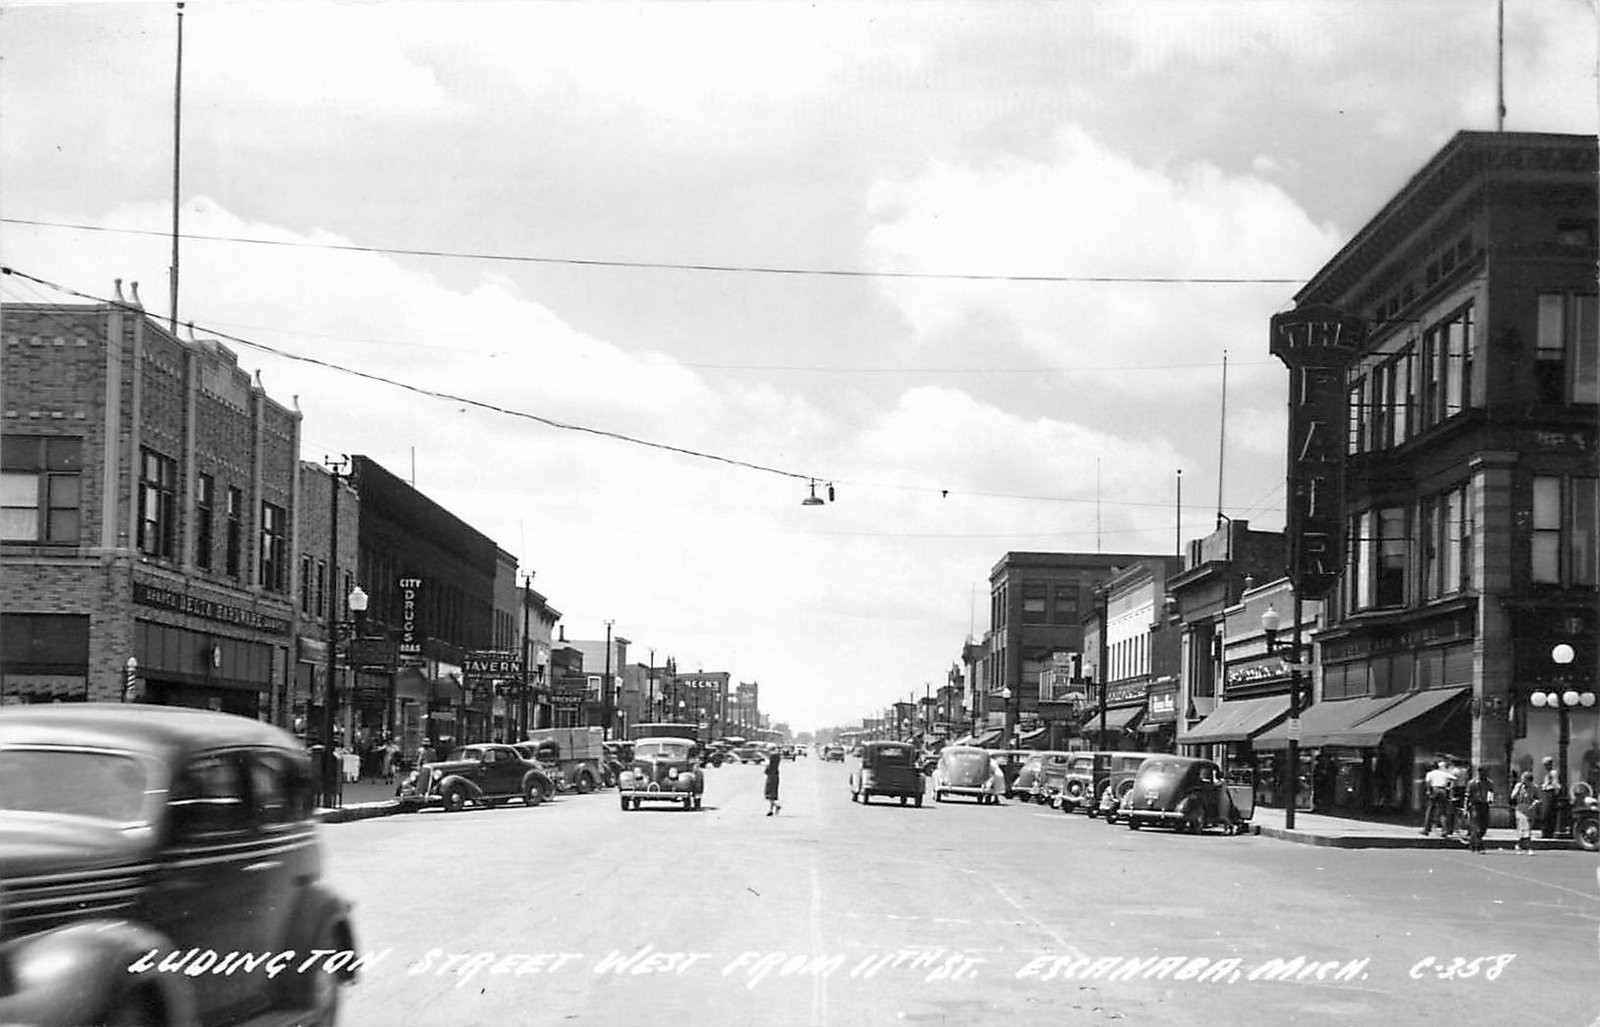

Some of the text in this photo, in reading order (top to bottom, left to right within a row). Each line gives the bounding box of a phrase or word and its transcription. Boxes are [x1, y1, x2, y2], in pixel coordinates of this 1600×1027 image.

[399, 578, 422, 588] CITY
[403, 589, 416, 642] DRUGS
[464, 660, 520, 672] TAVERN
